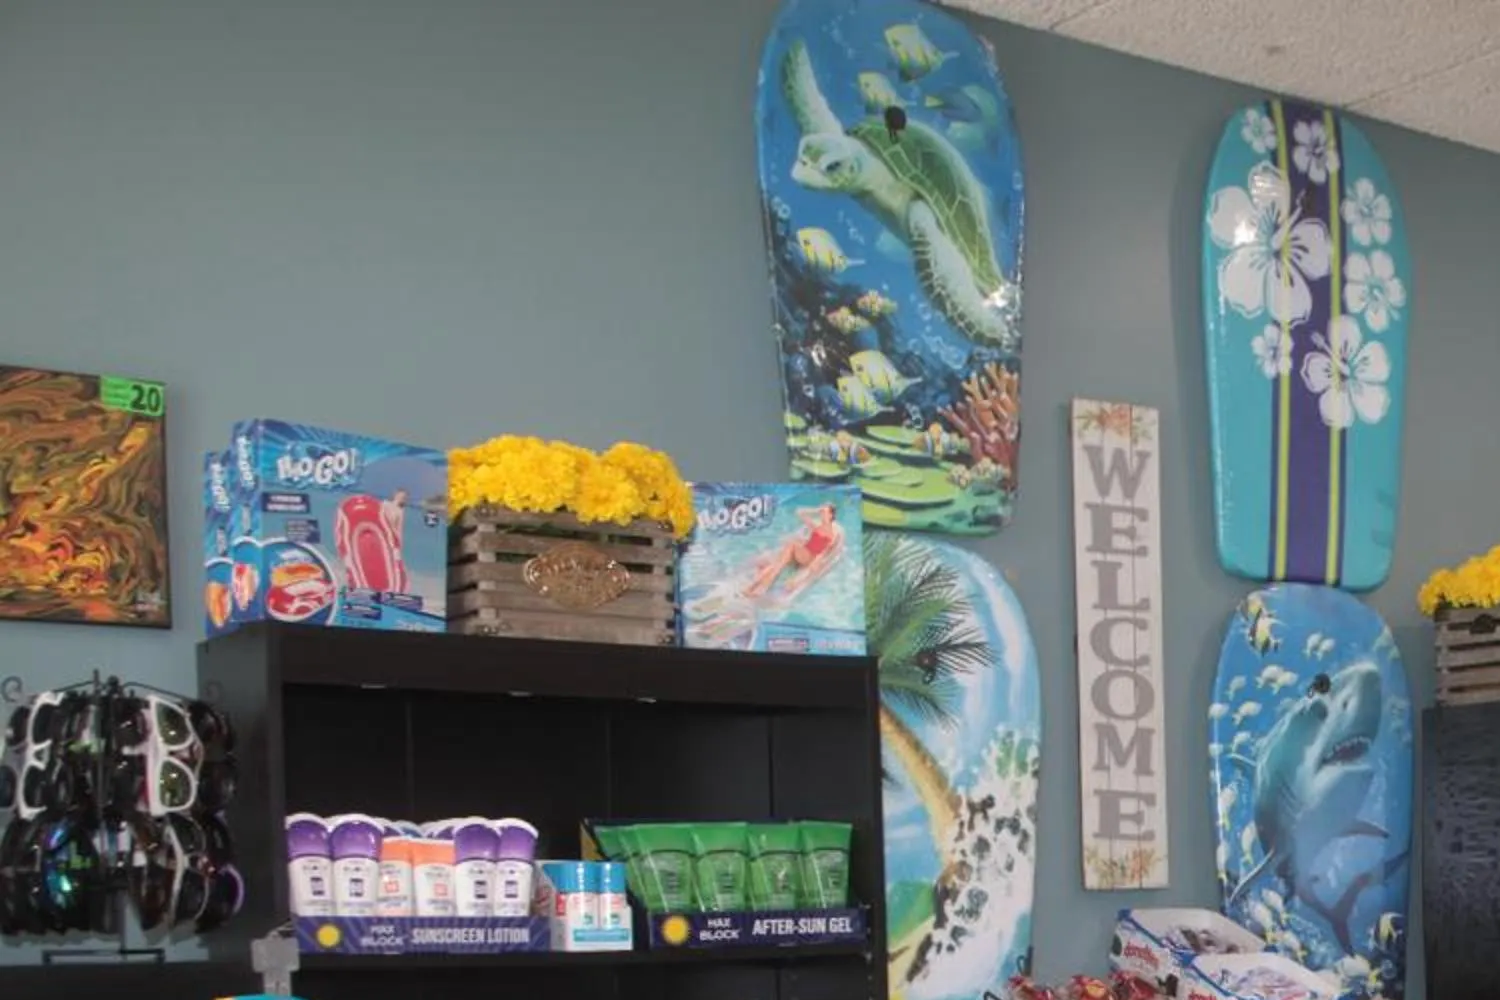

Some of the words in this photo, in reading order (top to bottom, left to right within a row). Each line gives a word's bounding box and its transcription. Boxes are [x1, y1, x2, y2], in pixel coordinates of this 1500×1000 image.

[130, 383, 161, 414] 20
[1081, 443, 1156, 842] WELCOME
[411, 927, 485, 944] SUNSCREEN
[487, 927, 530, 944] LOTION
[752, 917, 826, 936] AFTER-SUN
[829, 916, 854, 933] GEL
